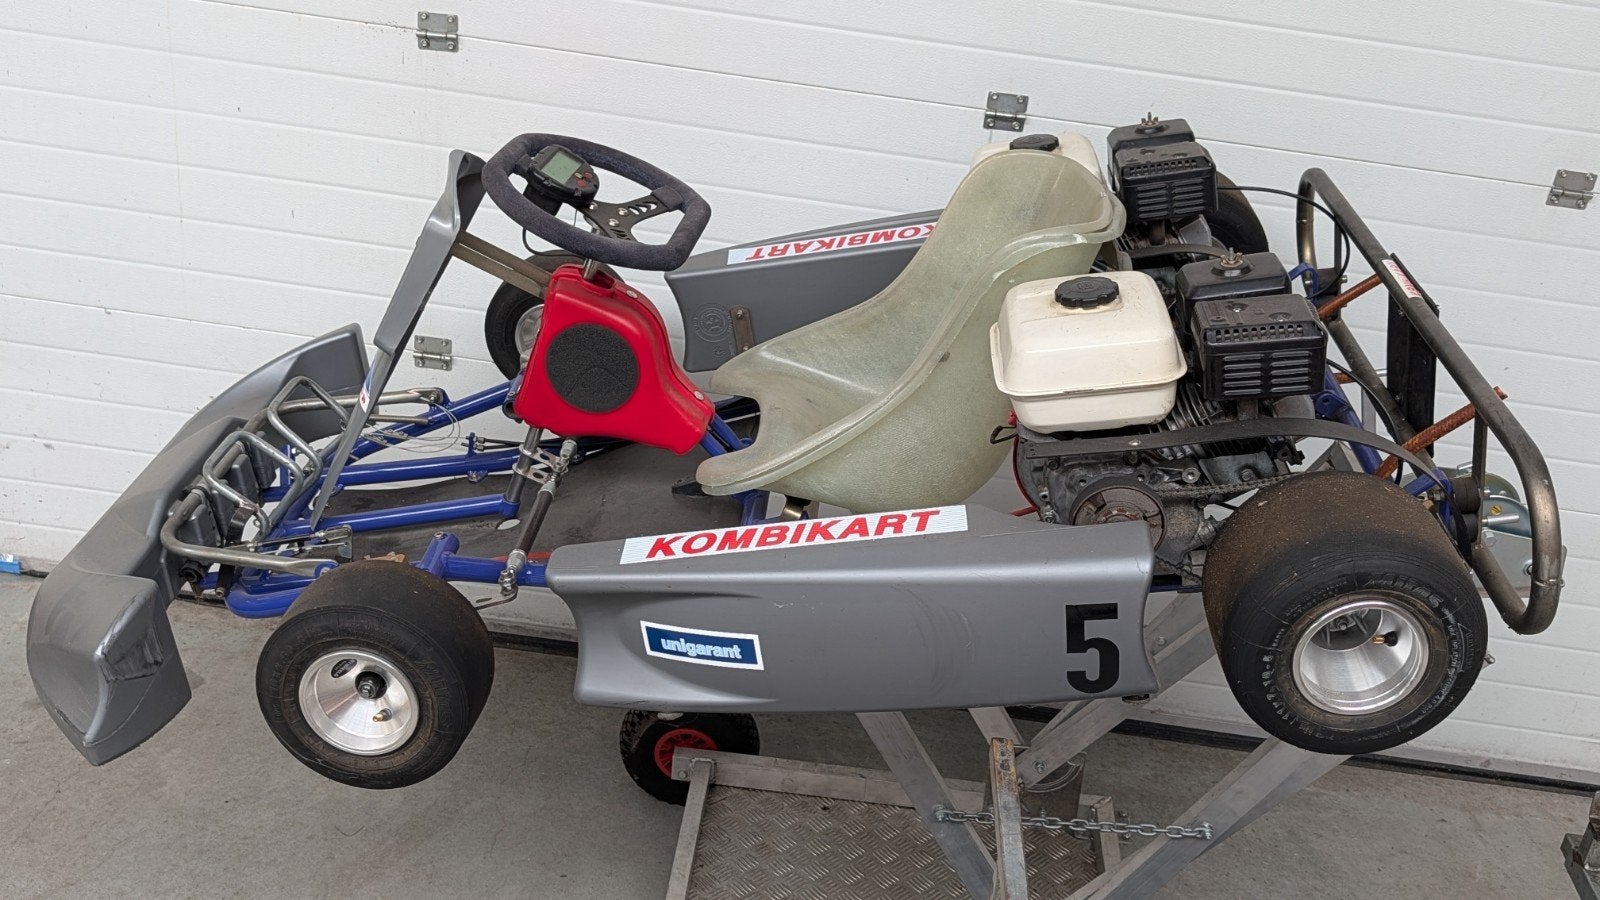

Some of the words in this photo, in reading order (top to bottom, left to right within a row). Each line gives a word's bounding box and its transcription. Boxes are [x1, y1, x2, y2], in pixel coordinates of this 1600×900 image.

[646, 510, 940, 558] KOMBIKART
[660, 638, 742, 659] unigarant
[1065, 602, 1119, 693] 5
